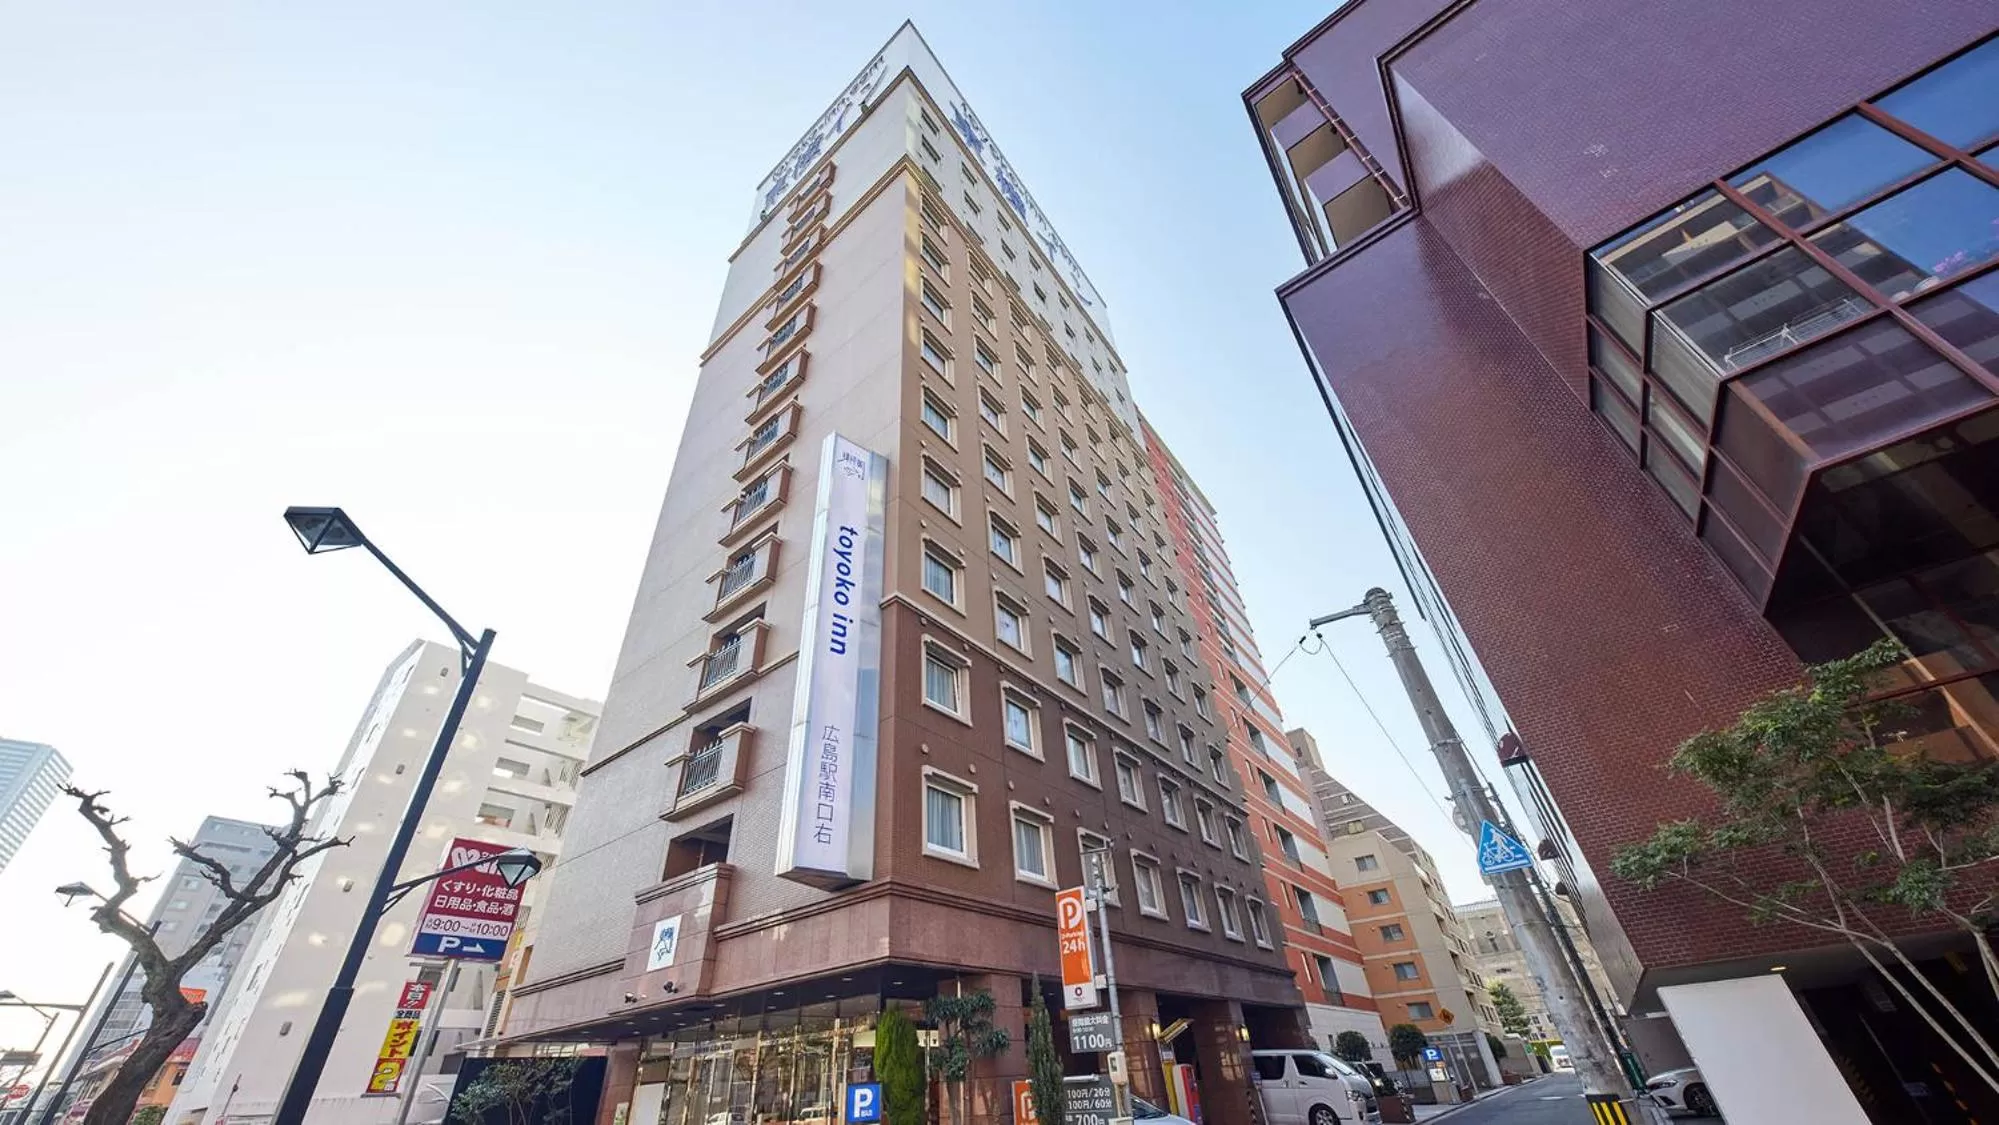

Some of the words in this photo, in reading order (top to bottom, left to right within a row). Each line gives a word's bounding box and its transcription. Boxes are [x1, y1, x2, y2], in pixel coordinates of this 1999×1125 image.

[832, 525, 859, 606] toyoko
[829, 612, 854, 656] inn
[813, 725, 841, 845] 広島駅南口右
[1059, 897, 1083, 929] P
[437, 935, 461, 953] P
[1063, 939, 1086, 954] 24h
[1073, 1033, 1113, 1049] 1100円
[1425, 1048, 1437, 1060] P
[853, 1088, 874, 1118] P
